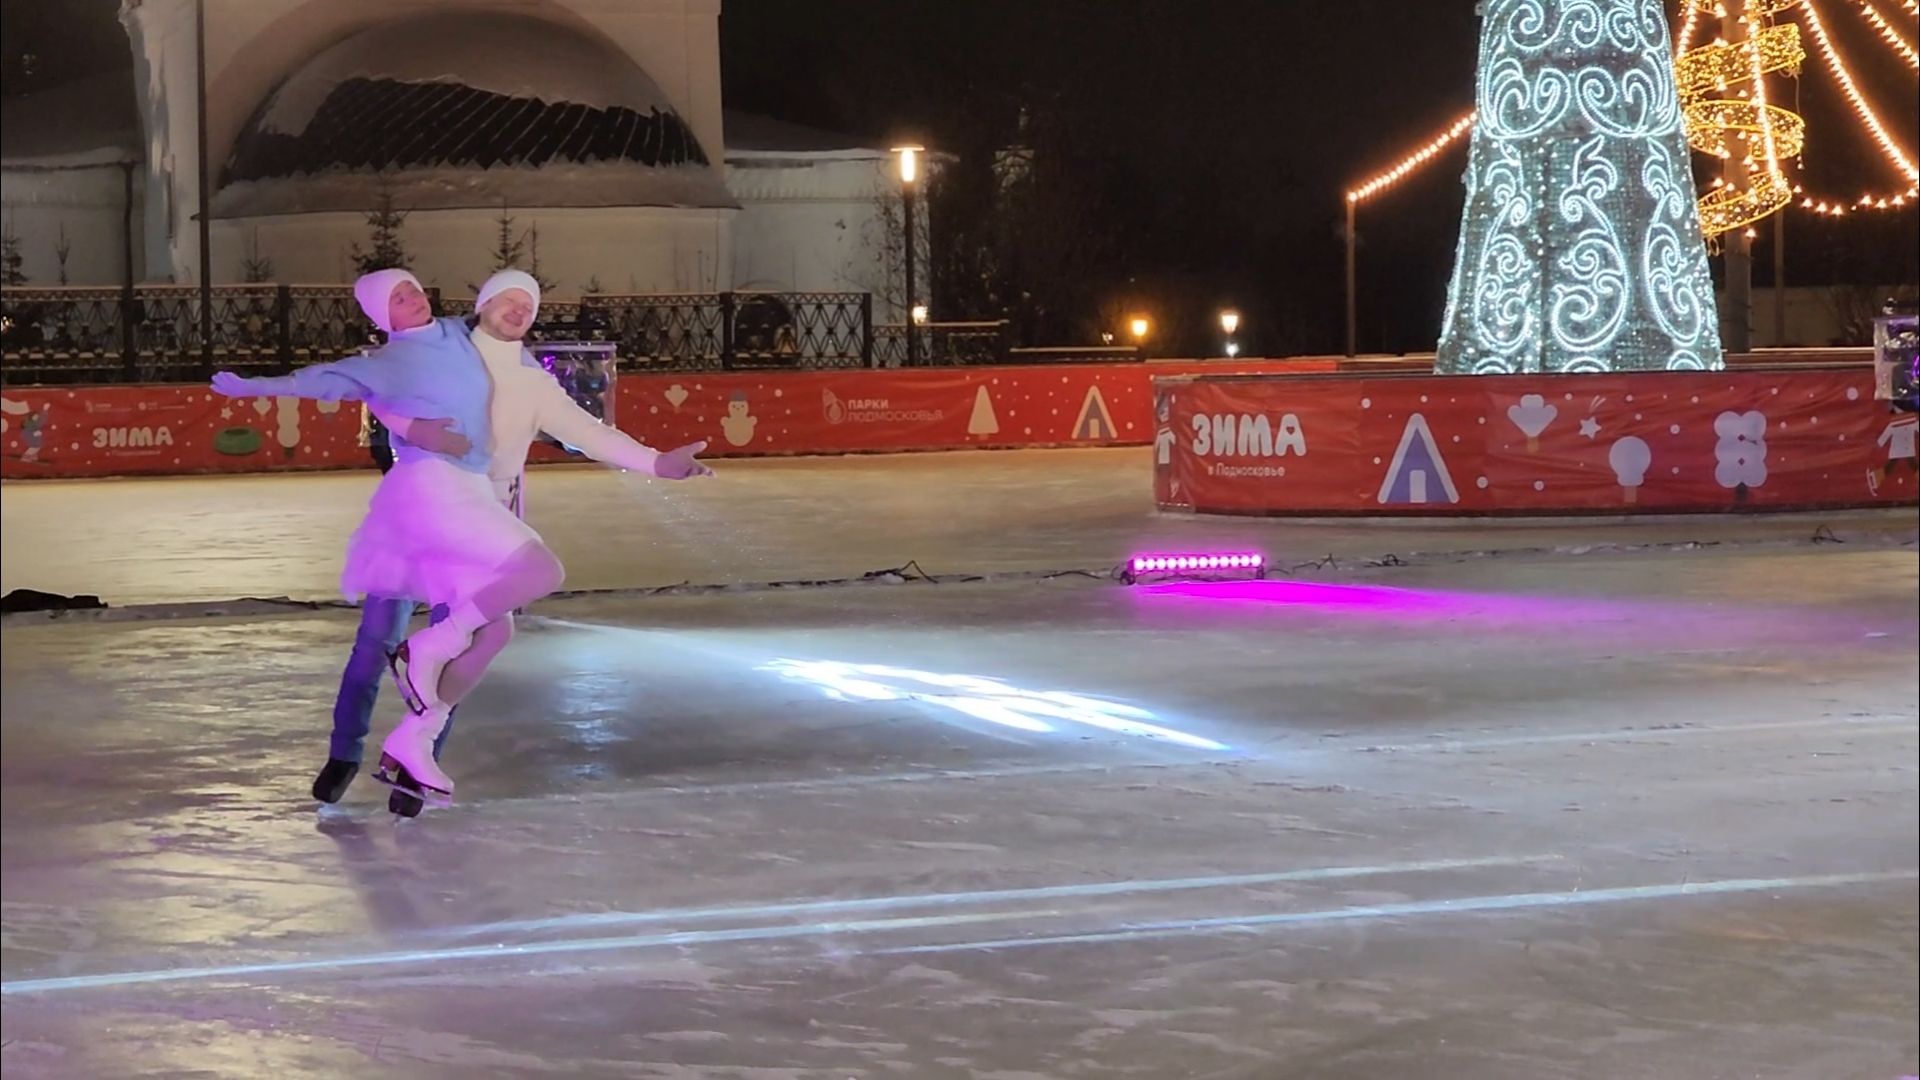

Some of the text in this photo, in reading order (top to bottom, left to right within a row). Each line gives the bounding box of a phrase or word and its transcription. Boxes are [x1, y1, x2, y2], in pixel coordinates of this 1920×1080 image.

[848, 399, 889, 410] ПАРКИ
[848, 410, 944, 422] ПОДМОСКОВЬЯ
[92, 426, 174, 448] ЗИМА
[1192, 413, 1307, 457] ЗИМА
[1216, 462, 1286, 478] Подмосковье
